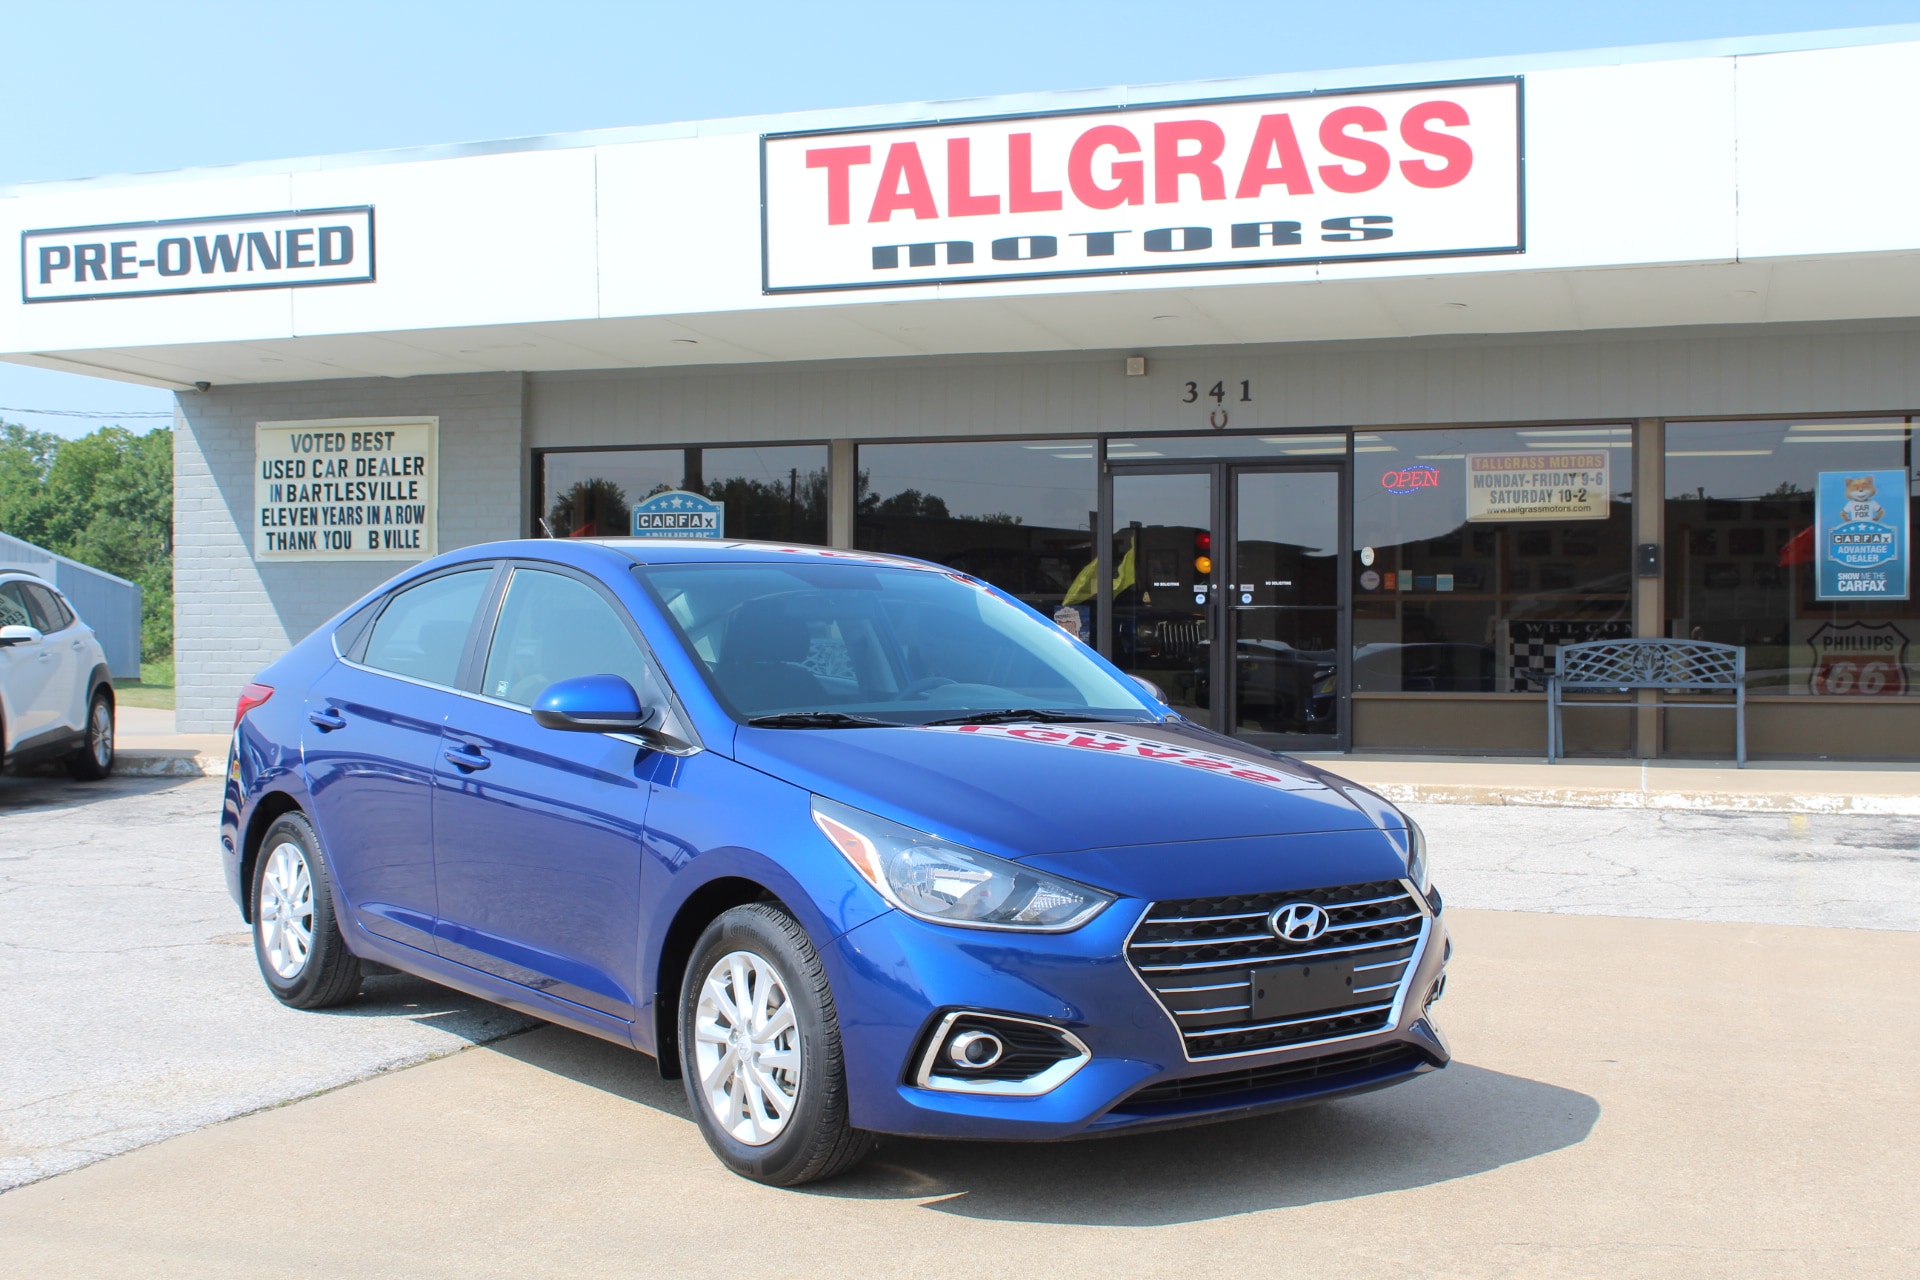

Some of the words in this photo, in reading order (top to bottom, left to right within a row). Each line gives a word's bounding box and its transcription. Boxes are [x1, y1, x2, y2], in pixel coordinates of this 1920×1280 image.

[805, 100, 1474, 226] TALLGRASS
[872, 215, 1394, 270] MOTORS
[39, 225, 355, 285] PRE-OWNED
[291, 433, 345, 453] VOTED
[351, 431, 395, 451] BEST
[263, 460, 306, 479] USED
[313, 459, 348, 478] CAR
[356, 456, 424, 477] DEALER
[1475, 456, 1545, 470] TALLGRASS
[1550, 455, 1603, 468] MOTORS
[1382, 470, 1440, 488] OPEN
[1473, 472, 1577, 488] MONDAY-FRIDAY
[1581, 472, 1603, 486] 9-6
[270, 484, 282, 502] IN
[287, 481, 418, 502] BARTLESVILLE
[1490, 489, 1554, 504] SATURDAY
[1559, 488, 1587, 502] 10-2
[262, 507, 318, 526] ELEVEN
[322, 506, 363, 525] YEARS
[367, 505, 380, 525] IN
[384, 505, 393, 524] A
[396, 505, 425, 524] ROW
[1487, 505, 1592, 515] www.tallgrassmotors.com
[640, 514, 714, 528] CARFAX
[266, 531, 317, 550] THANK
[323, 530, 352, 550] YOU
[369, 530, 379, 549] B
[384, 529, 420, 549] VILLE
[1834, 534, 1891, 544] CARFAX
[1838, 545, 1888, 554] ADVANTAGE
[1846, 554, 1879, 563] DEALER
[1837, 572, 1860, 580] SHOW
[1860, 572, 1872, 580] ME
[1873, 572, 1886, 580] THE
[1838, 580, 1887, 592] CARFAX
[1525, 623, 1633, 634] WELCO
[1823, 635, 1894, 651] PHILLIPS
[1826, 661, 1889, 694] 66
